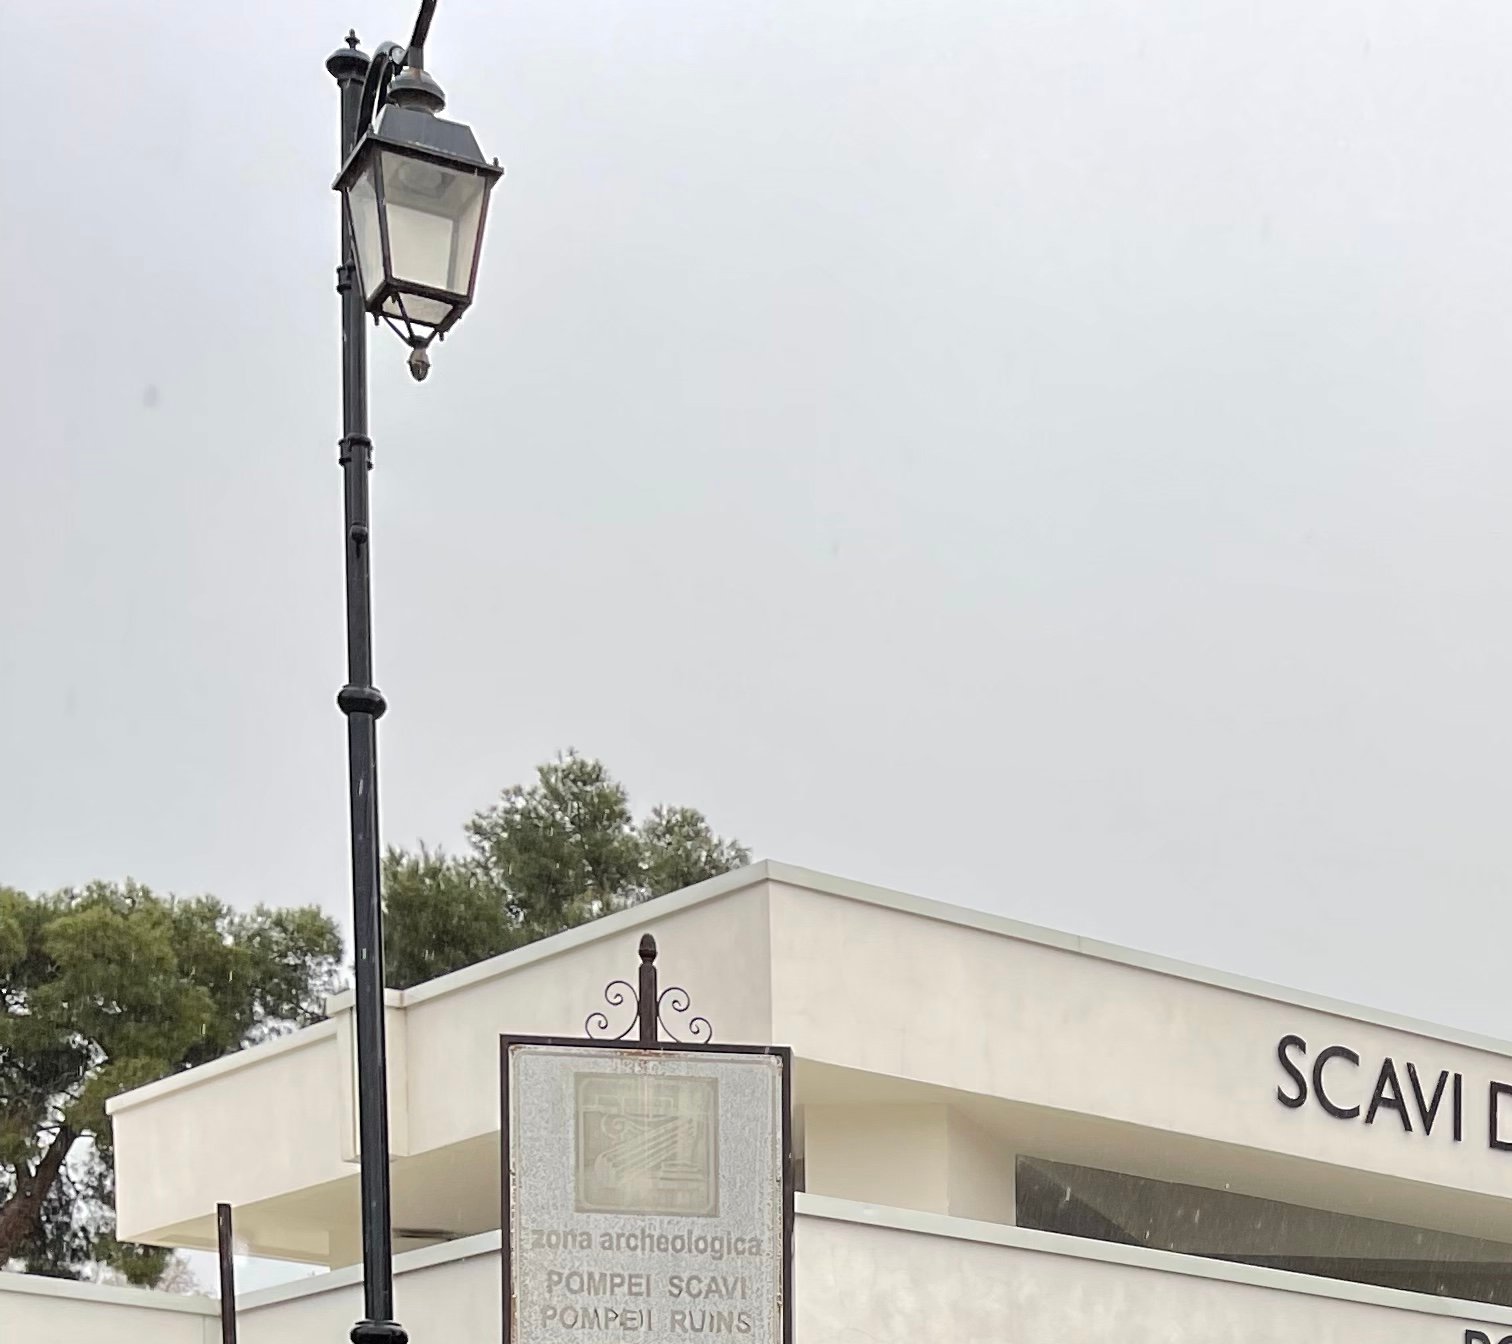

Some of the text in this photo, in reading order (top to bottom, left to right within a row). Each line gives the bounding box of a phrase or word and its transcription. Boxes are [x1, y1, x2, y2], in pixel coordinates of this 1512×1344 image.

[1277, 1034, 1463, 1142] SCAVI
[531, 1228, 763, 1261] zona archeologica
[546, 1269, 747, 1300] POMPEI SCAVI
[541, 1304, 752, 1334] POMPEII RUINS
